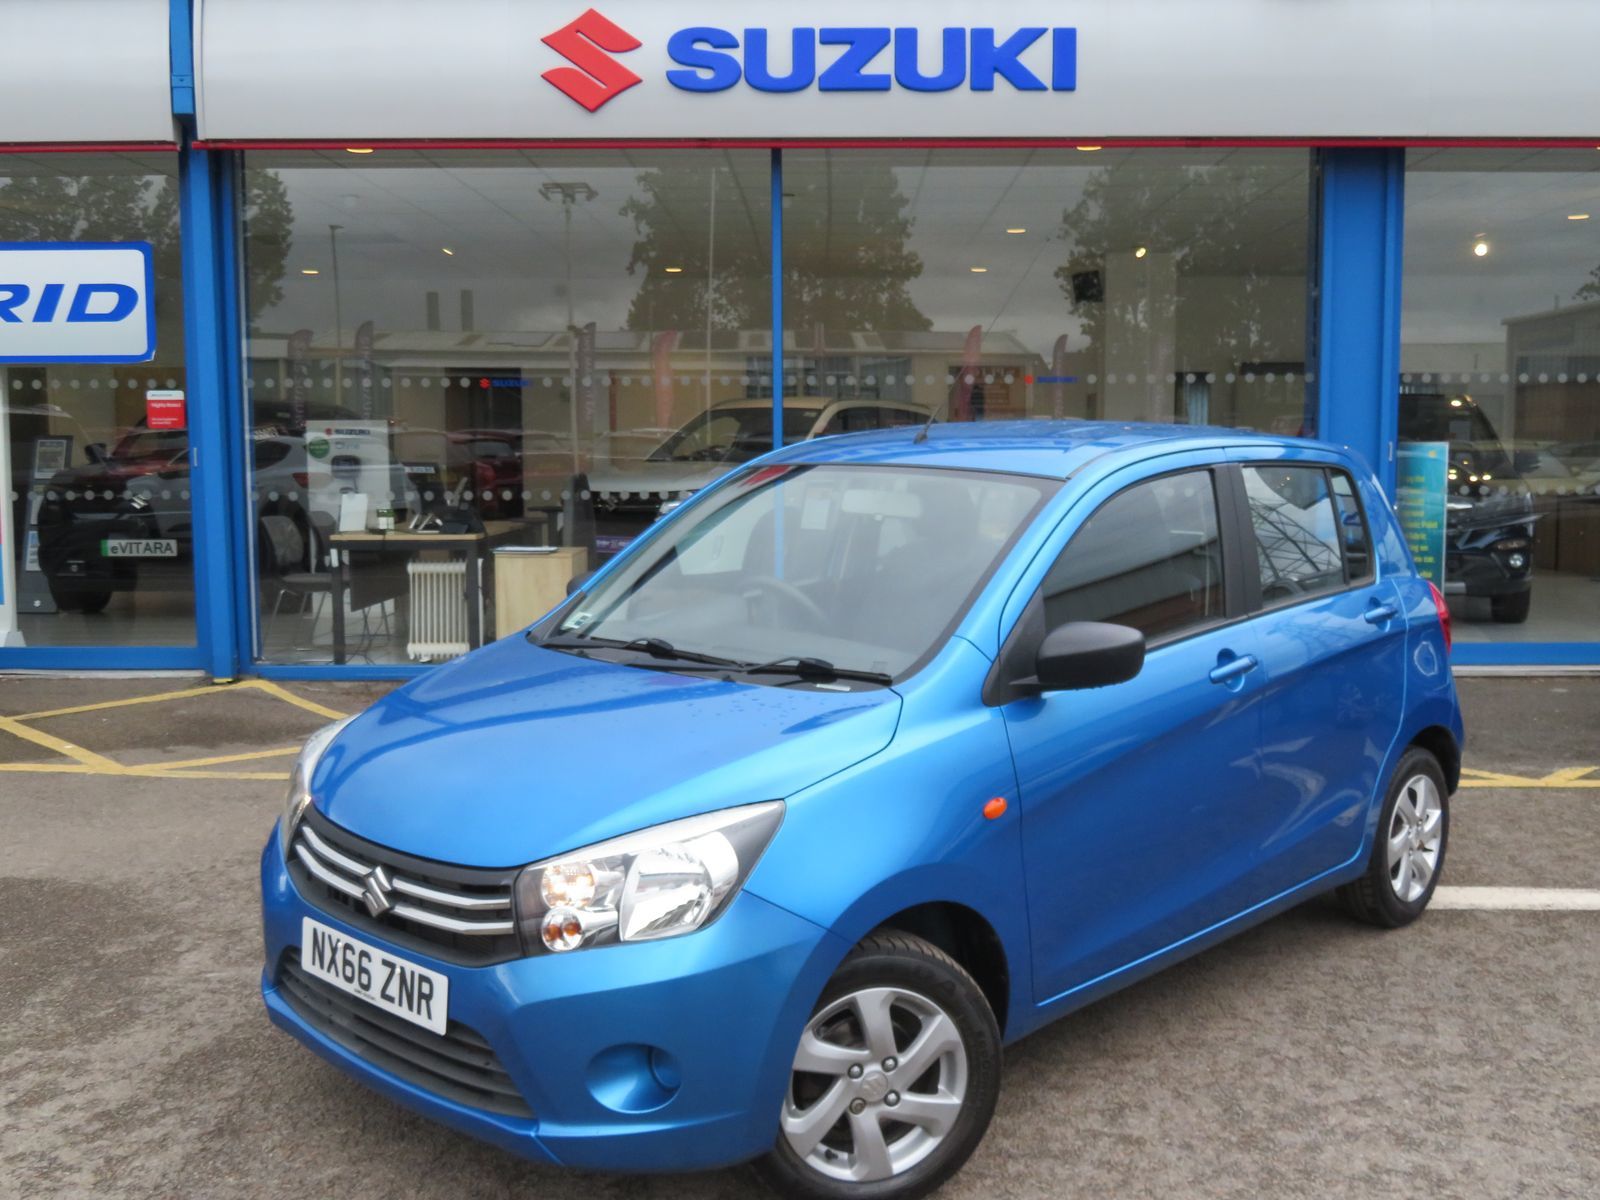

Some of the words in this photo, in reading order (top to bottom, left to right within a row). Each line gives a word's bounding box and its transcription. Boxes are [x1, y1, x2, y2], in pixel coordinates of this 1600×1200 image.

[666, 27, 1077, 94] SUZUKI
[110, 541, 174, 555] eVITARA
[312, 927, 372, 992] NX66
[380, 958, 434, 1021] ZNR
